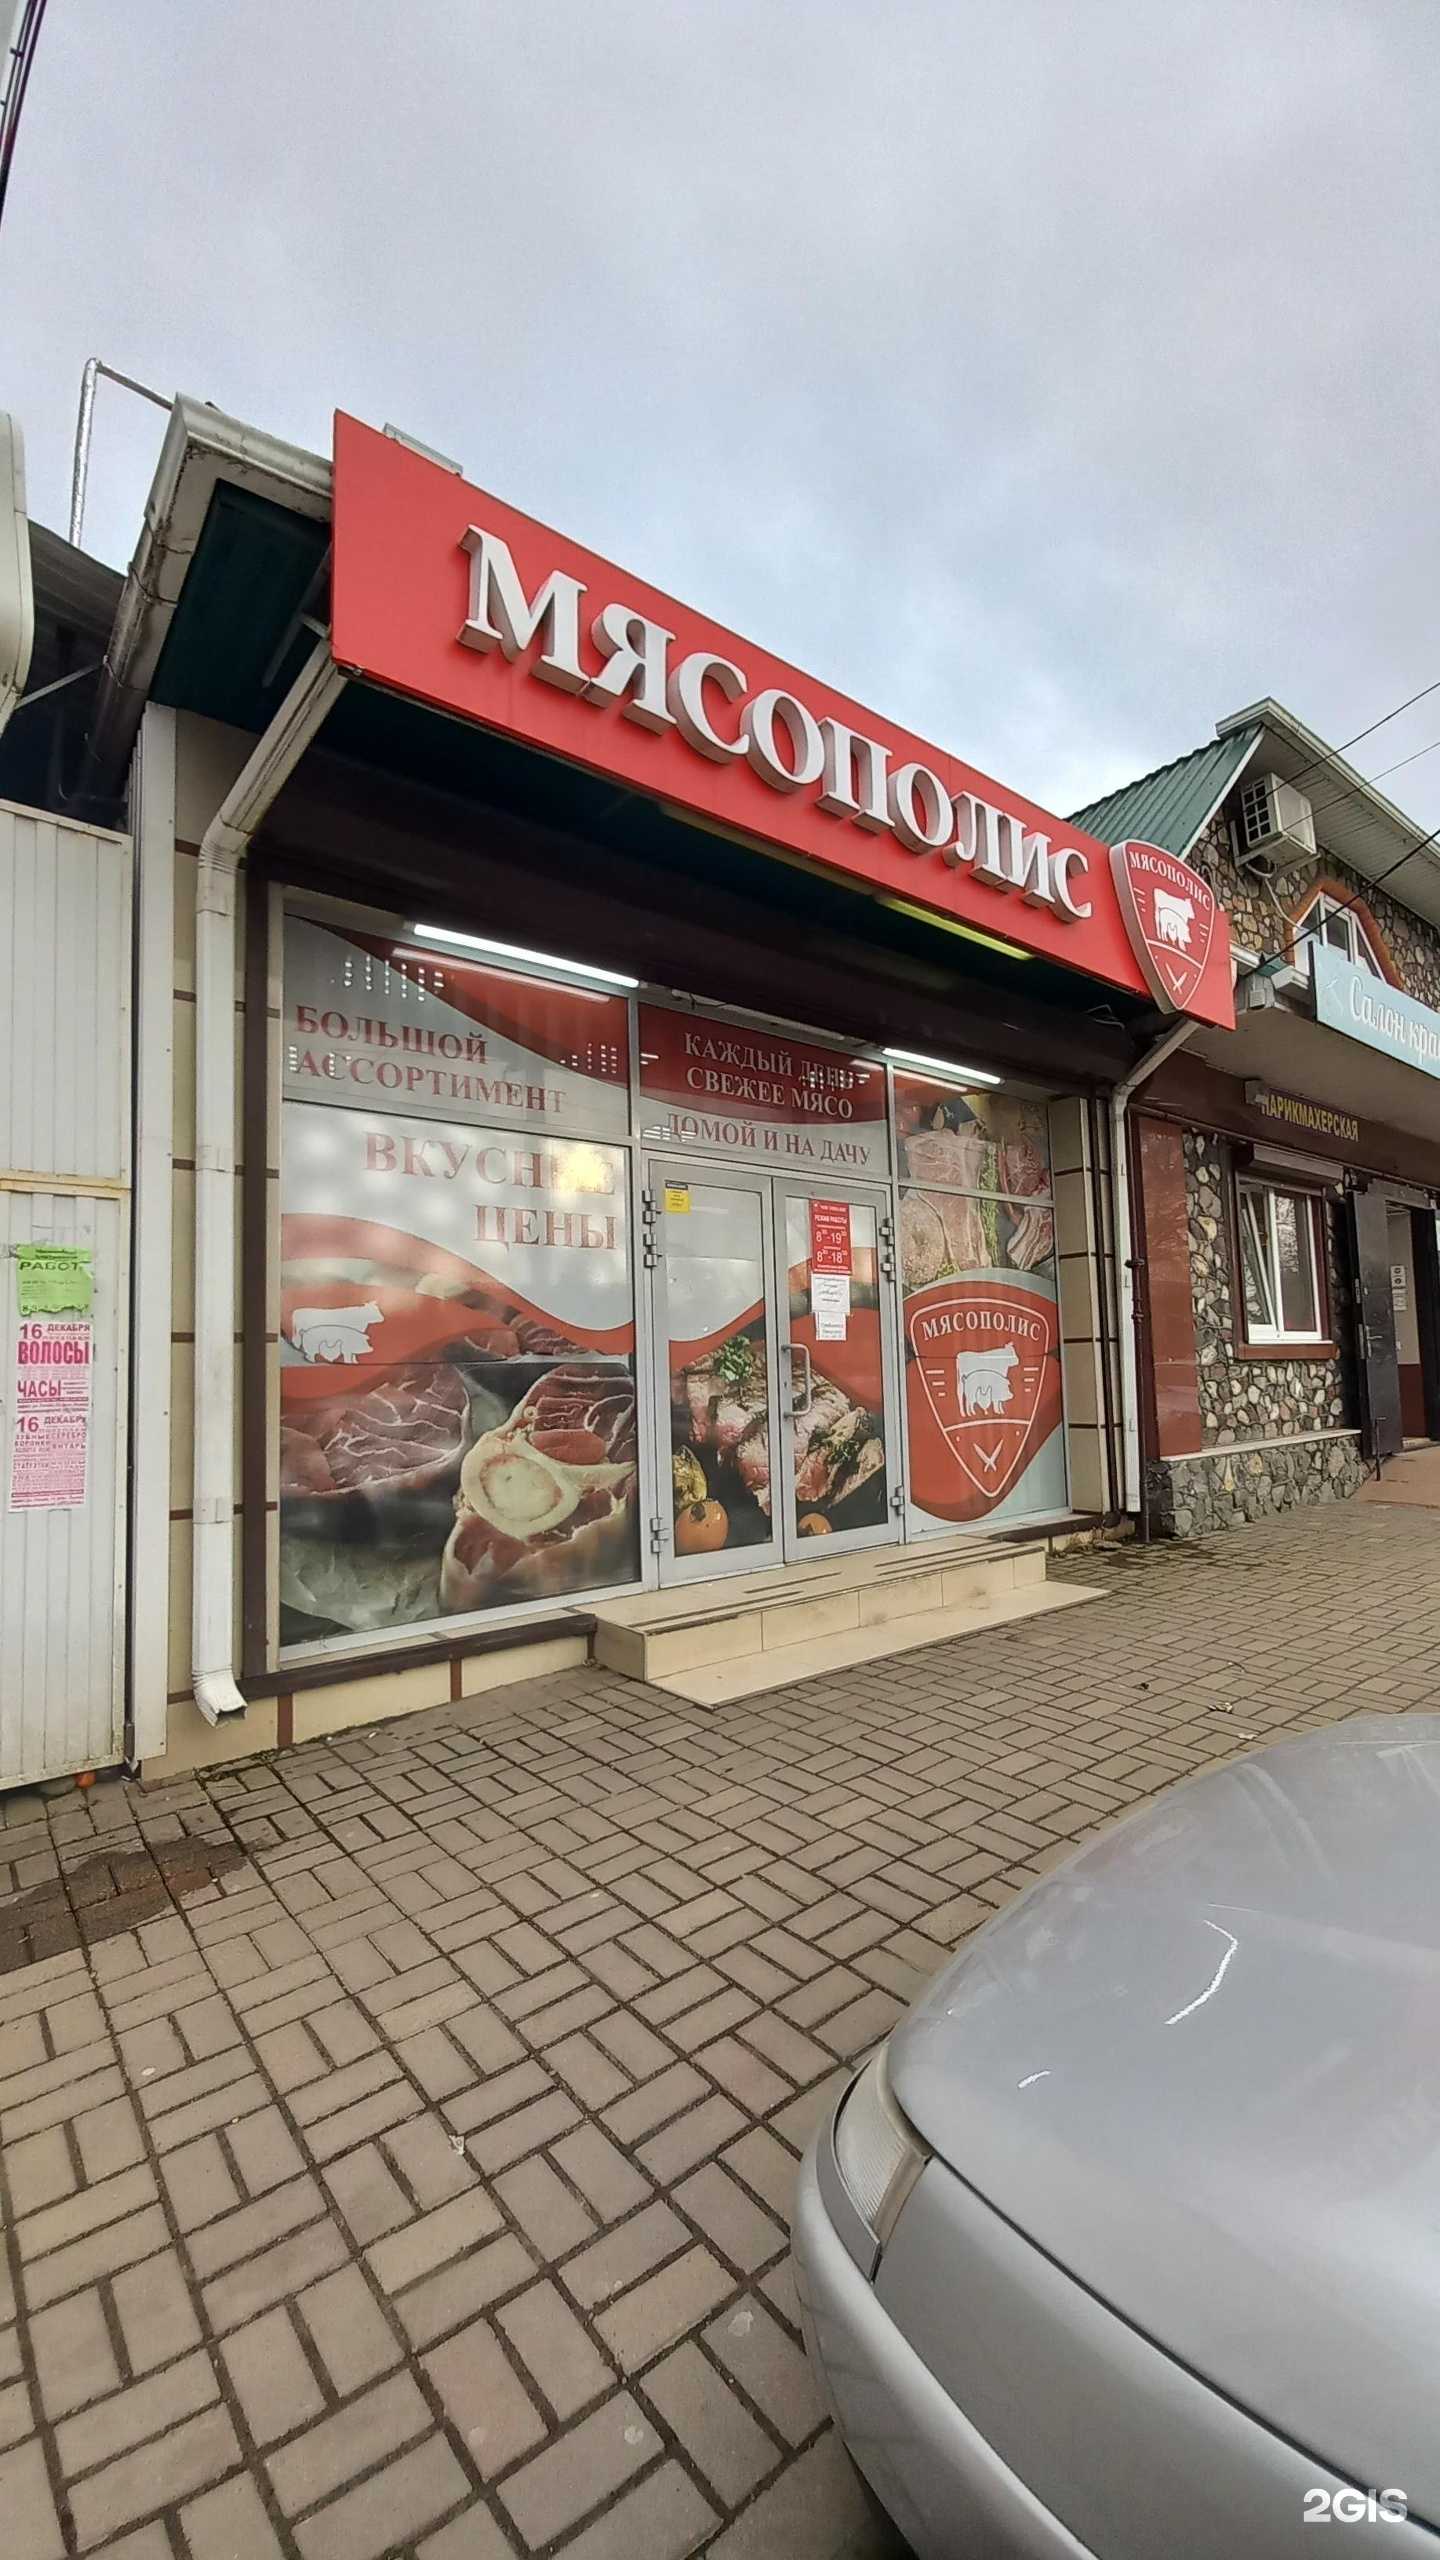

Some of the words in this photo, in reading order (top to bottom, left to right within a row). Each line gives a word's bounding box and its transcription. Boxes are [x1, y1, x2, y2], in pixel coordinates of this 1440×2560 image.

[458, 524, 1093, 923] МЯСОПОЛИС
[1128, 851, 1211, 912] МЯСОПОЛИС
[296, 1004, 488, 1065] БОЛЬШОЙ
[1351, 975, 1406, 1044] Салон
[1409, 1020, 1440, 1066] кра
[684, 1033, 793, 1077] КАЖДЫЙ
[297, 1050, 566, 1113] АССОРТИМЕНТ
[686, 1066, 786, 1105] СВЕЖЕЕ
[791, 1087, 854, 1119] МЯСО
[665, 1112, 757, 1148] ДОМОЙ
[764, 1130, 778, 1151] И
[785, 1134, 815, 1157] НА
[820, 1140, 871, 1166] ДАЧУ
[1262, 1093, 1360, 1143] ПАРИКМАХЕРСКАЯ
[363, 1131, 616, 1196] ВКУСНЕ
[473, 1204, 618, 1252] ЦЕНЫ
[20, 1323, 43, 1340] 16
[47, 1323, 90, 1332] ДЕКАБРЯ
[921, 1311, 1041, 1341] МЯСОПОЛИС
[18, 1341, 90, 1365] ВОЛОСЫ
[17, 1380, 62, 1397] ЧАСЫ
[16, 1416, 40, 1433] 16
